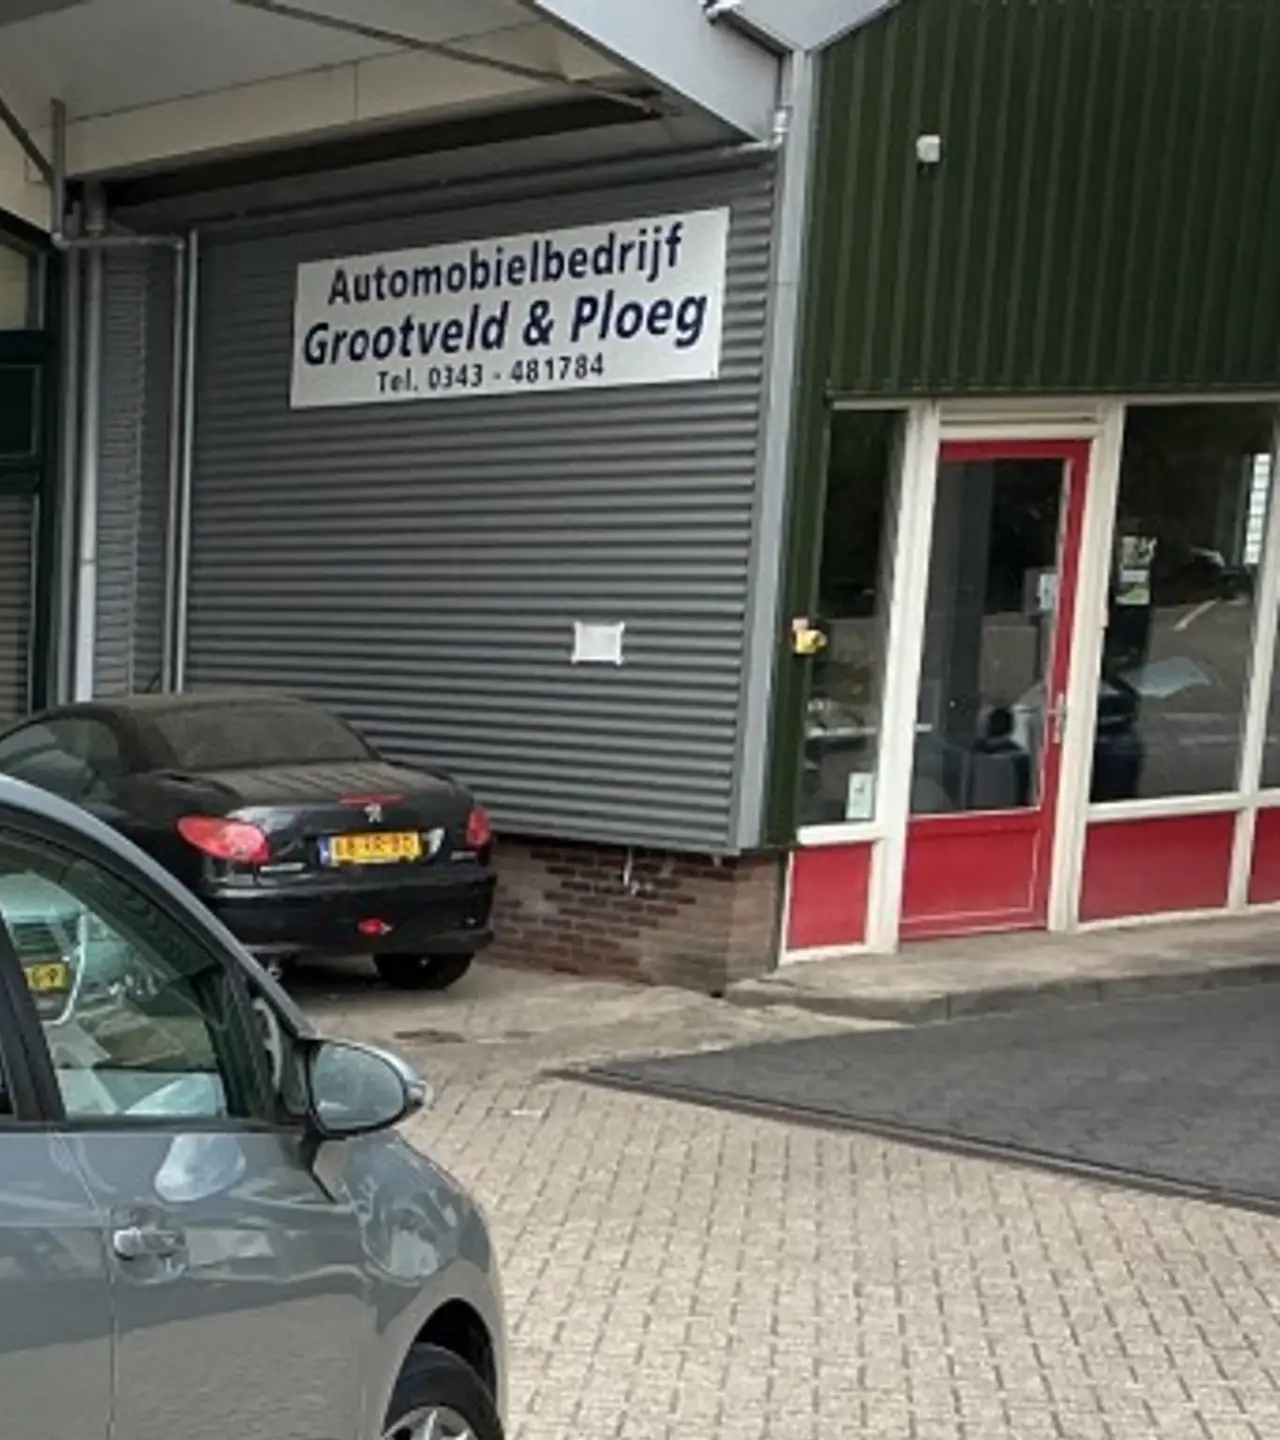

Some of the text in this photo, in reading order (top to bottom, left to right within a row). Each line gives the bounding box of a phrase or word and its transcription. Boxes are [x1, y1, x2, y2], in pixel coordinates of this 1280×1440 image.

[328, 222, 683, 305] Automobielbedrijf
[304, 289, 708, 364] Grootveld & Ploeg
[377, 370, 418, 393] Tel.
[429, 364, 483, 391] 0343
[510, 354, 604, 383] 481784
